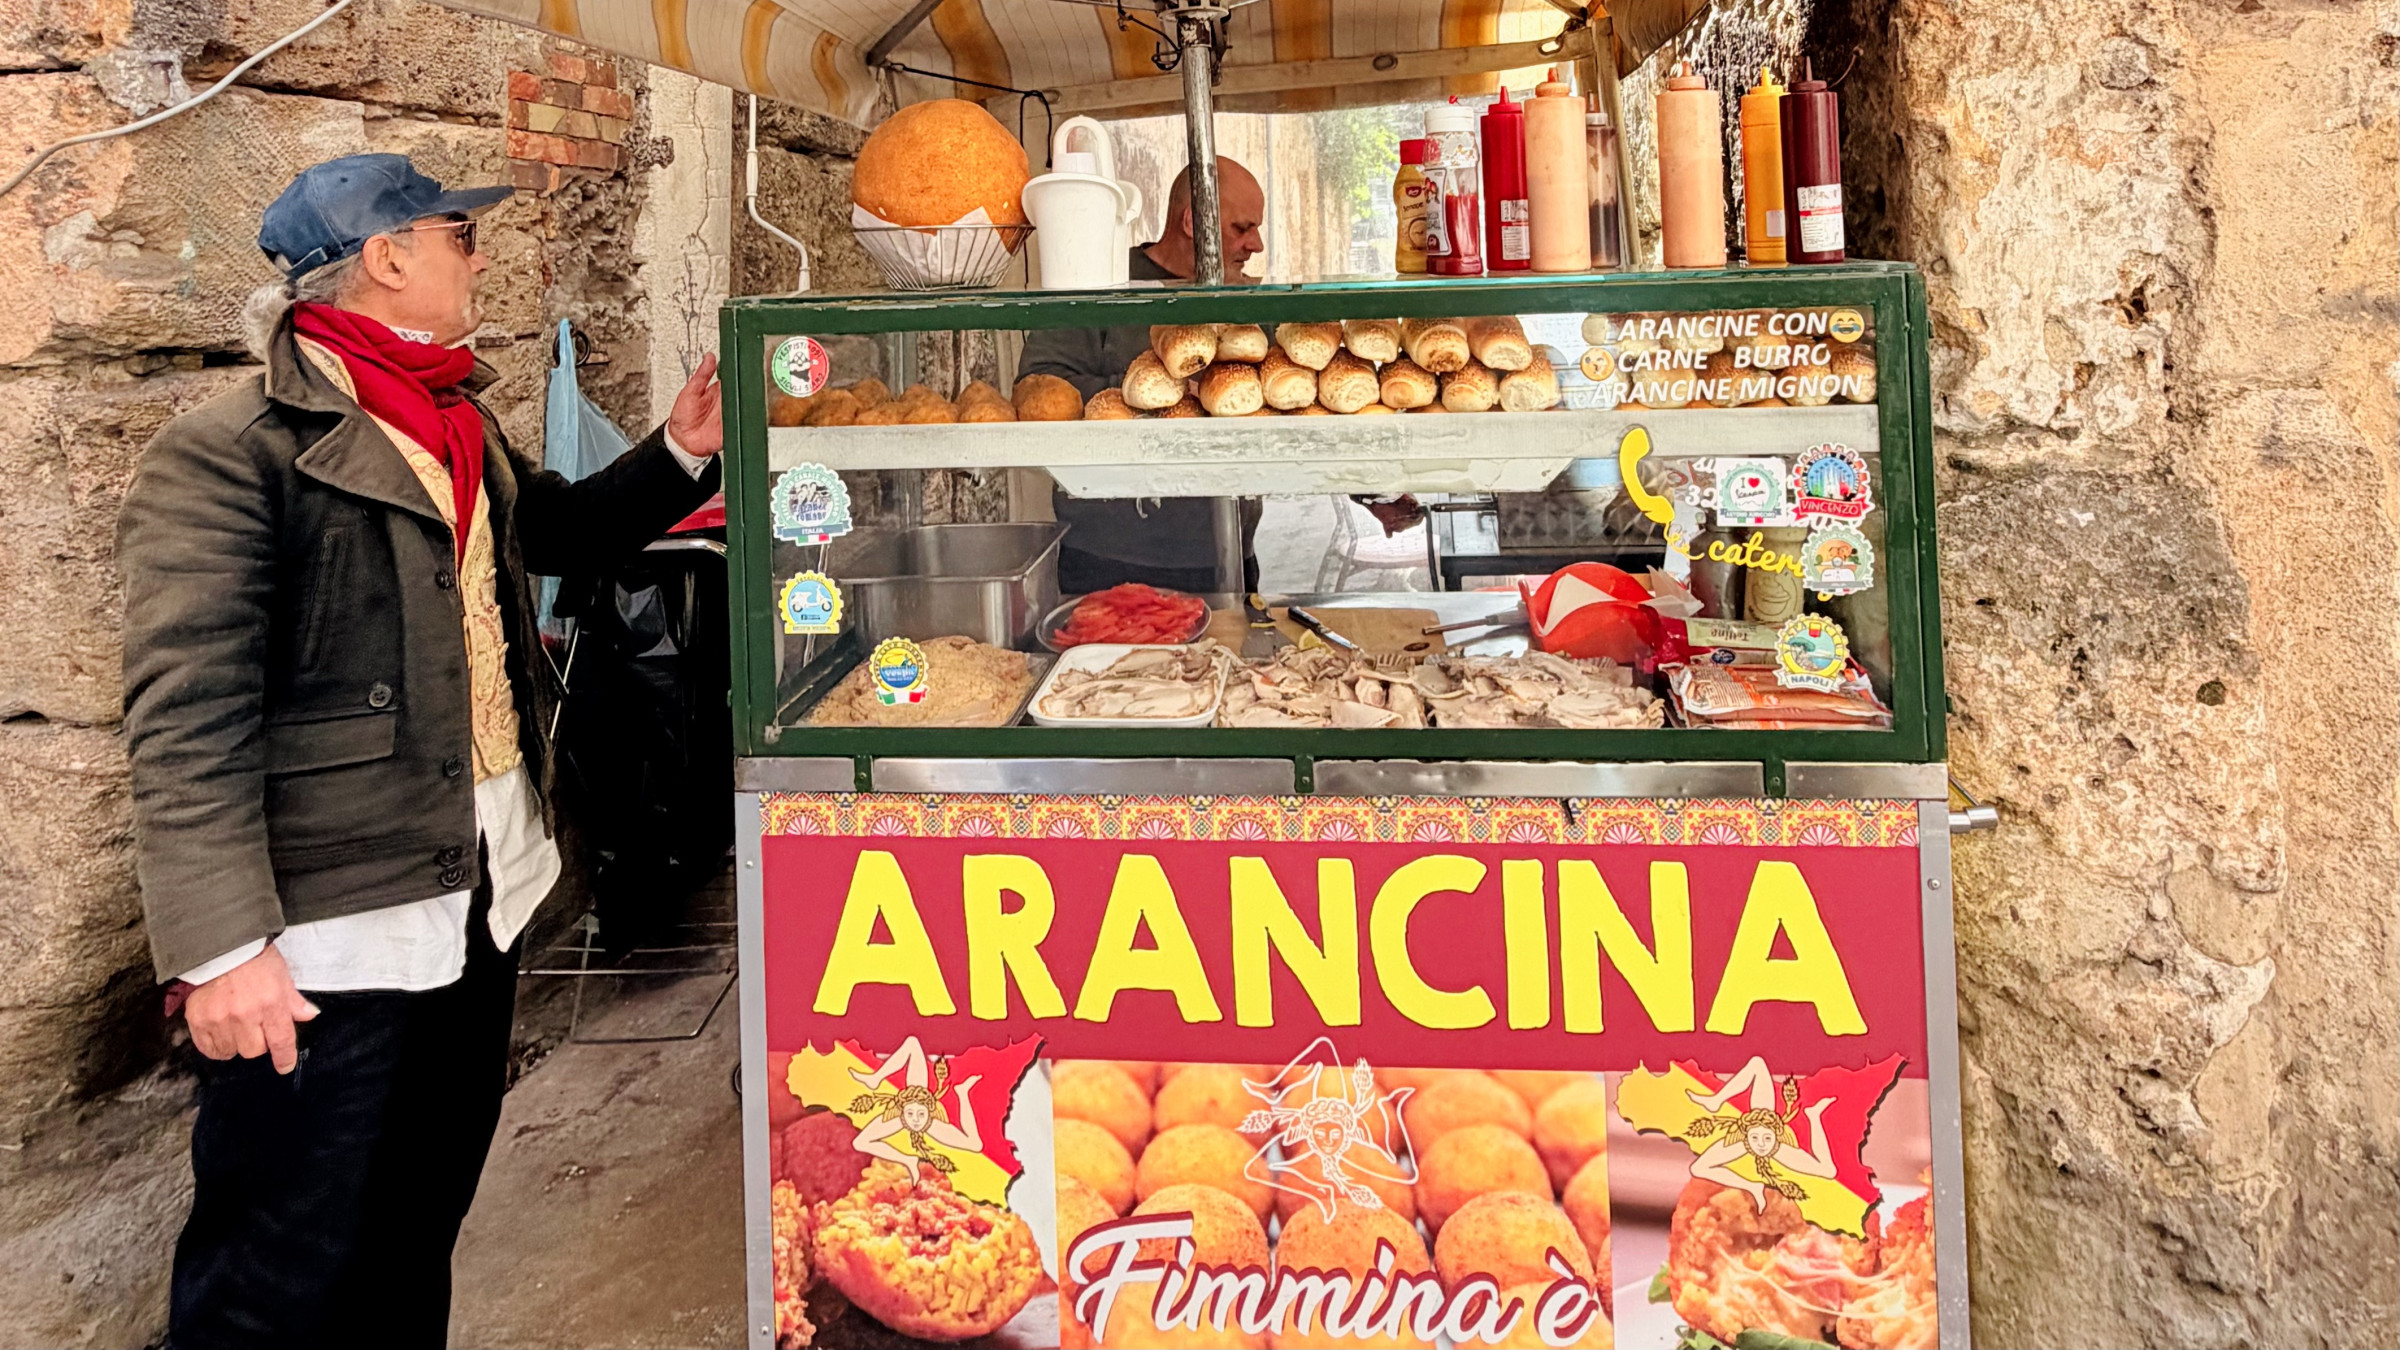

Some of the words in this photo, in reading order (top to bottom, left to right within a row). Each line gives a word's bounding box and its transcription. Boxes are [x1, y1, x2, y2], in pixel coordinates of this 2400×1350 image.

[1618, 316, 1760, 341] ARANCINE
[1768, 312, 1828, 335] CON
[1618, 348, 1708, 372] CARNE
[1734, 343, 1831, 368] BURRO
[1591, 378, 1732, 404] ARANCINE
[1739, 374, 1863, 400] MIGNON
[1801, 501, 1859, 515] VINCENZO
[802, 527, 824, 535] ITALIA
[1791, 675, 1829, 687] NAPOLI
[812, 849, 1869, 1036] ARANCINA
[1067, 1211, 1524, 1344] Fimmina
[1534, 1246, 1599, 1346] è
